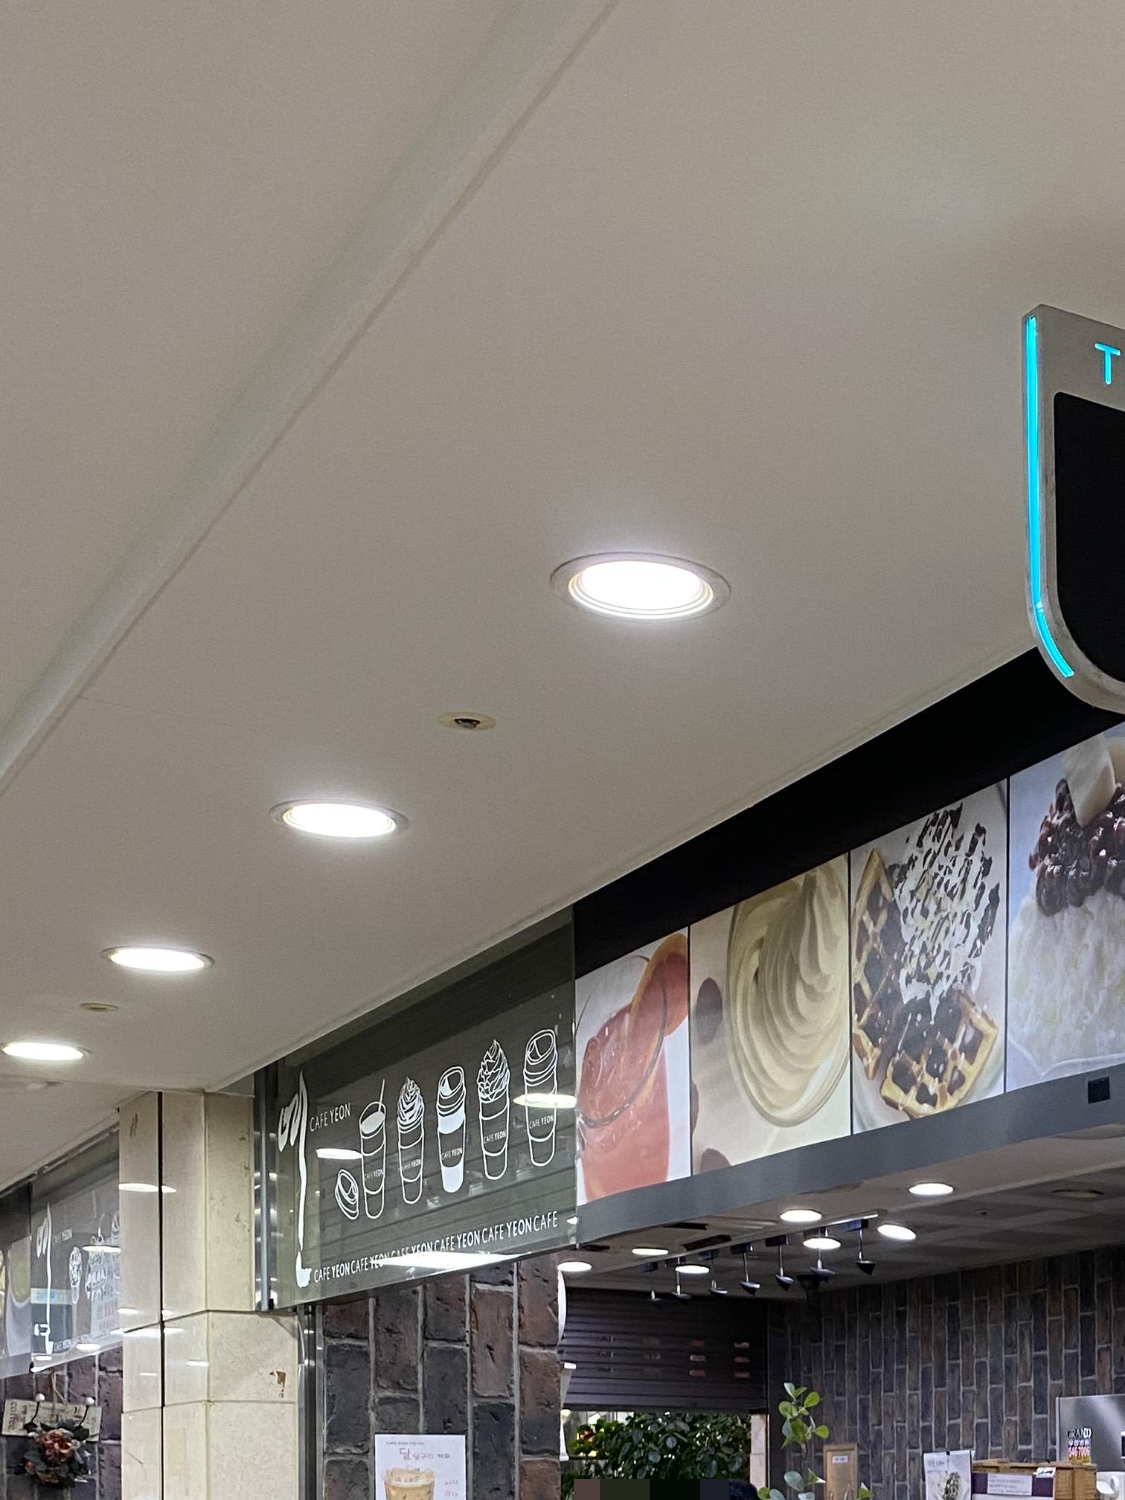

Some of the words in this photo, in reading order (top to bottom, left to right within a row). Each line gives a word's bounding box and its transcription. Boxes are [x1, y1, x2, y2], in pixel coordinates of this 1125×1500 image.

[309, 1109, 328, 1132] CAFE
[329, 1102, 351, 1125] YEON
[313, 1266, 330, 1283] CAFE
[331, 1261, 350, 1279] YEON
[351, 1257, 368, 1275] CAFE
[434, 1235, 455, 1251] CAFE
[456, 1229, 480, 1248] YEON
[481, 1223, 504, 1243] CAFE
[506, 1217, 532, 1238] YEON
[533, 1210, 558, 1231] CAFE
